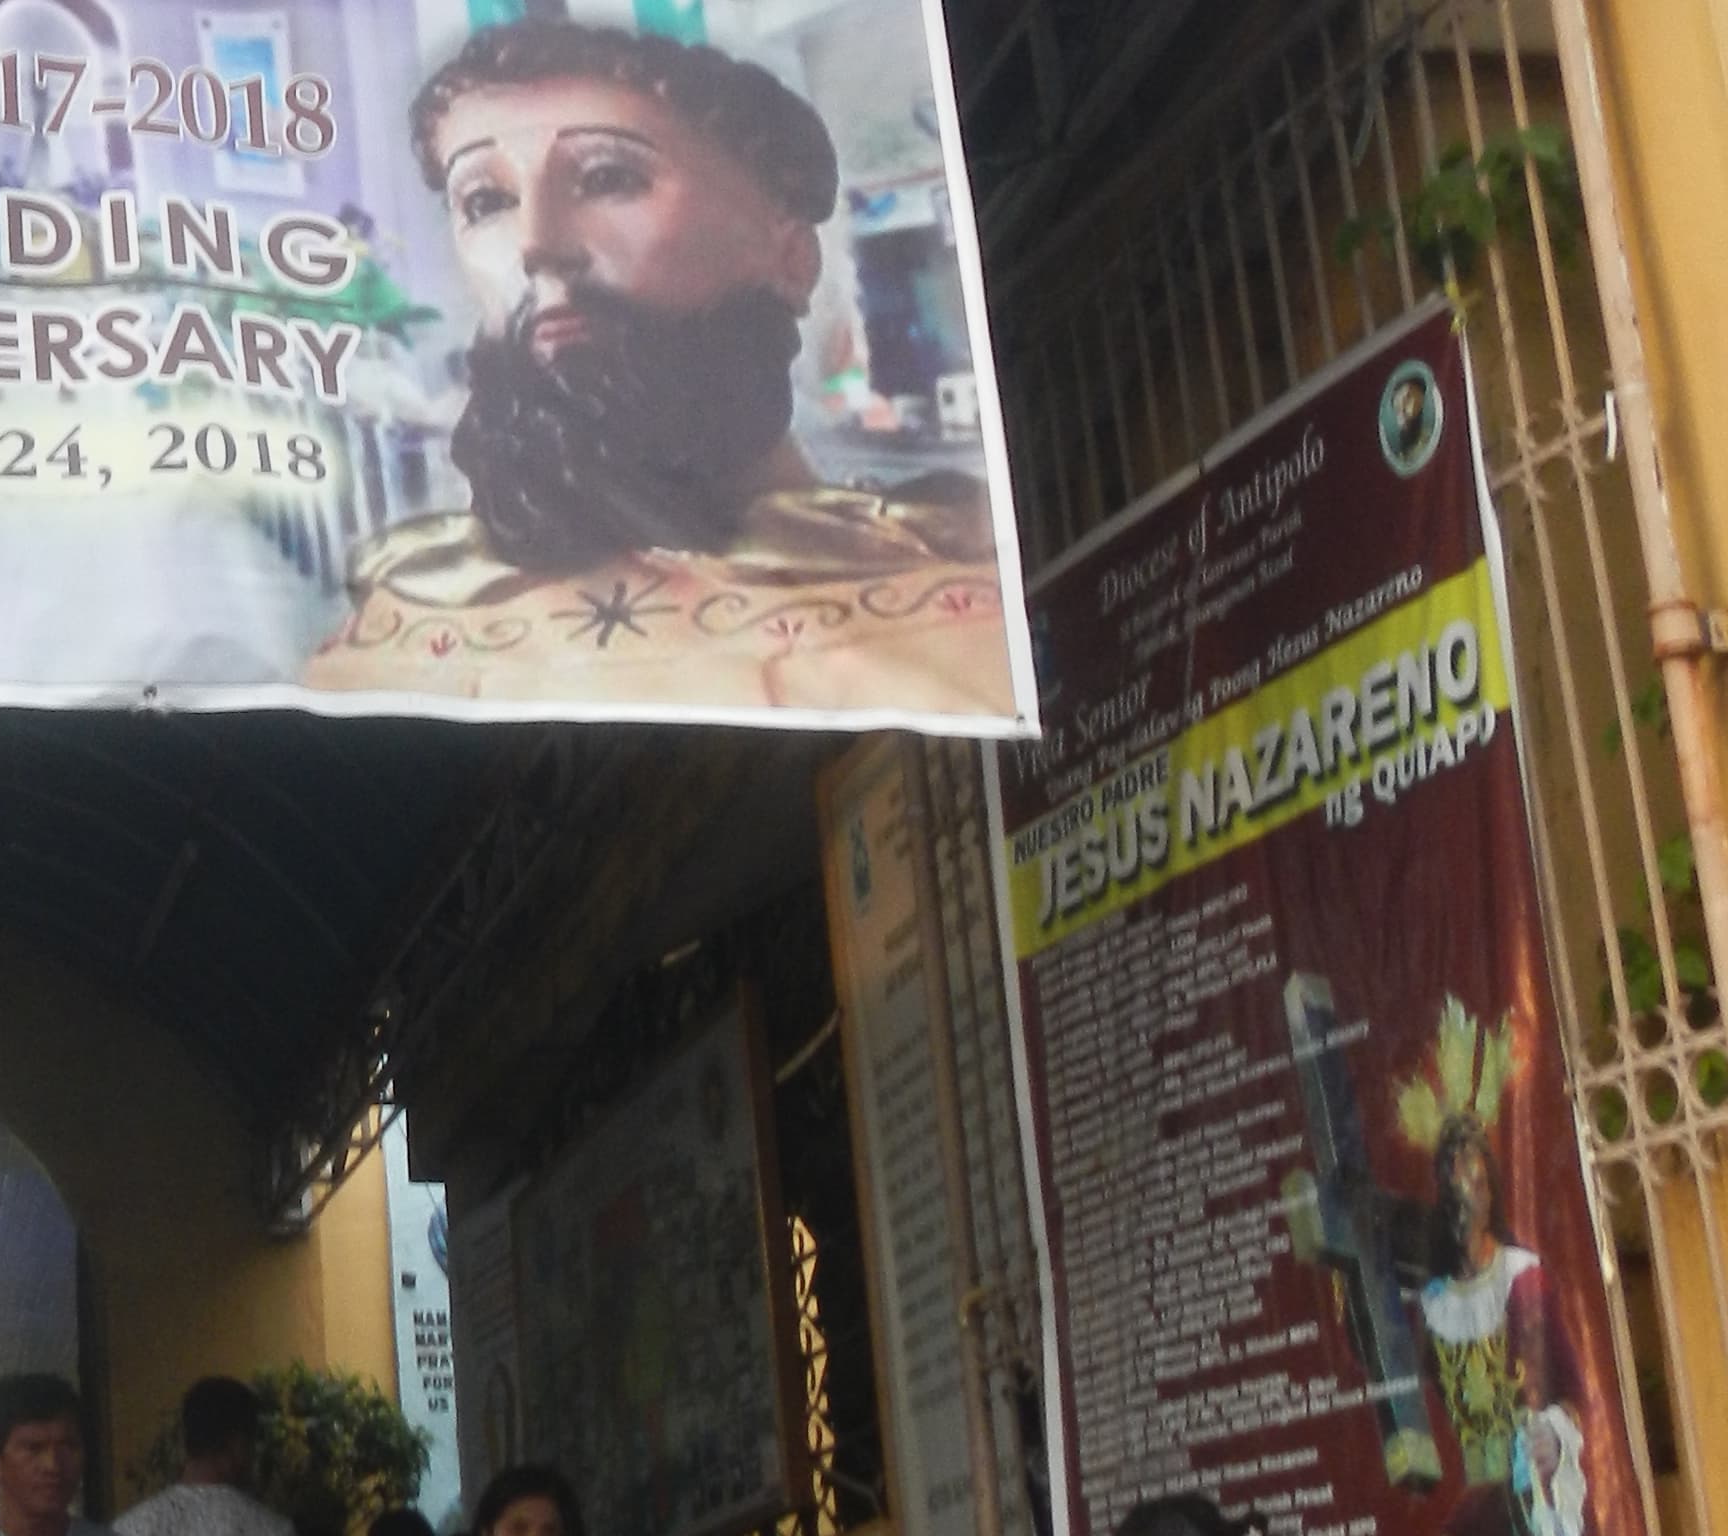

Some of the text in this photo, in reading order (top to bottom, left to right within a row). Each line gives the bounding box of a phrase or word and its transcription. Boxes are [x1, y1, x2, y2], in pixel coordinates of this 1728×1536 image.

[148, 421, 330, 484] 2018
[1186, 491, 1212, 555] of
[1216, 422, 1326, 537] Antipolo
[1323, 564, 1424, 640] Nazareno
[1011, 749, 1170, 865] NUESTRO PADRE
[1036, 619, 1481, 930] JESUS NAZARENO
[413, 1310, 448, 1326] MAM
[415, 1332, 449, 1346] MAR
[417, 1354, 451, 1370] PRA
